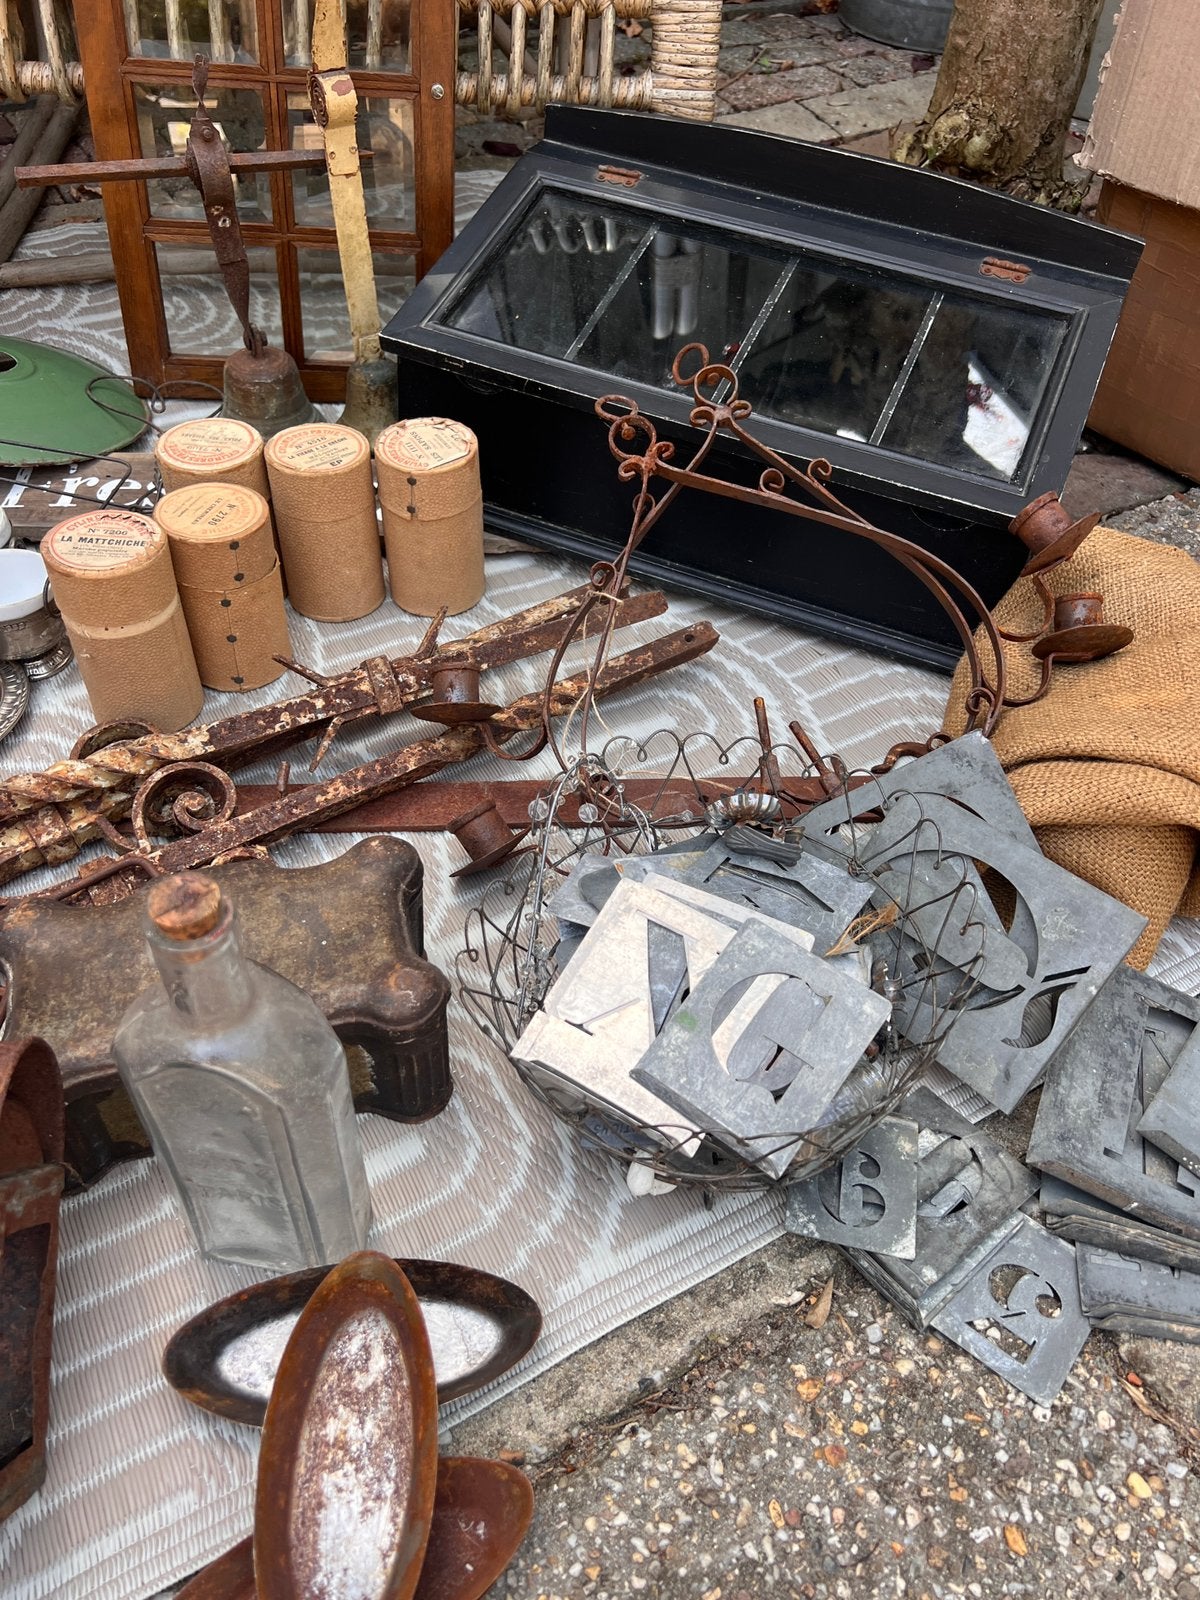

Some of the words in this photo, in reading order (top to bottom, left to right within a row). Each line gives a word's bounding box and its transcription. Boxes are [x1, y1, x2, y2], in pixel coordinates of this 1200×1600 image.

[329, 459, 343, 467] EP
[60, 535, 73, 543] LA
[78, 536, 147, 547] MATTCHICHE
[817, 1150, 887, 1228] 6
